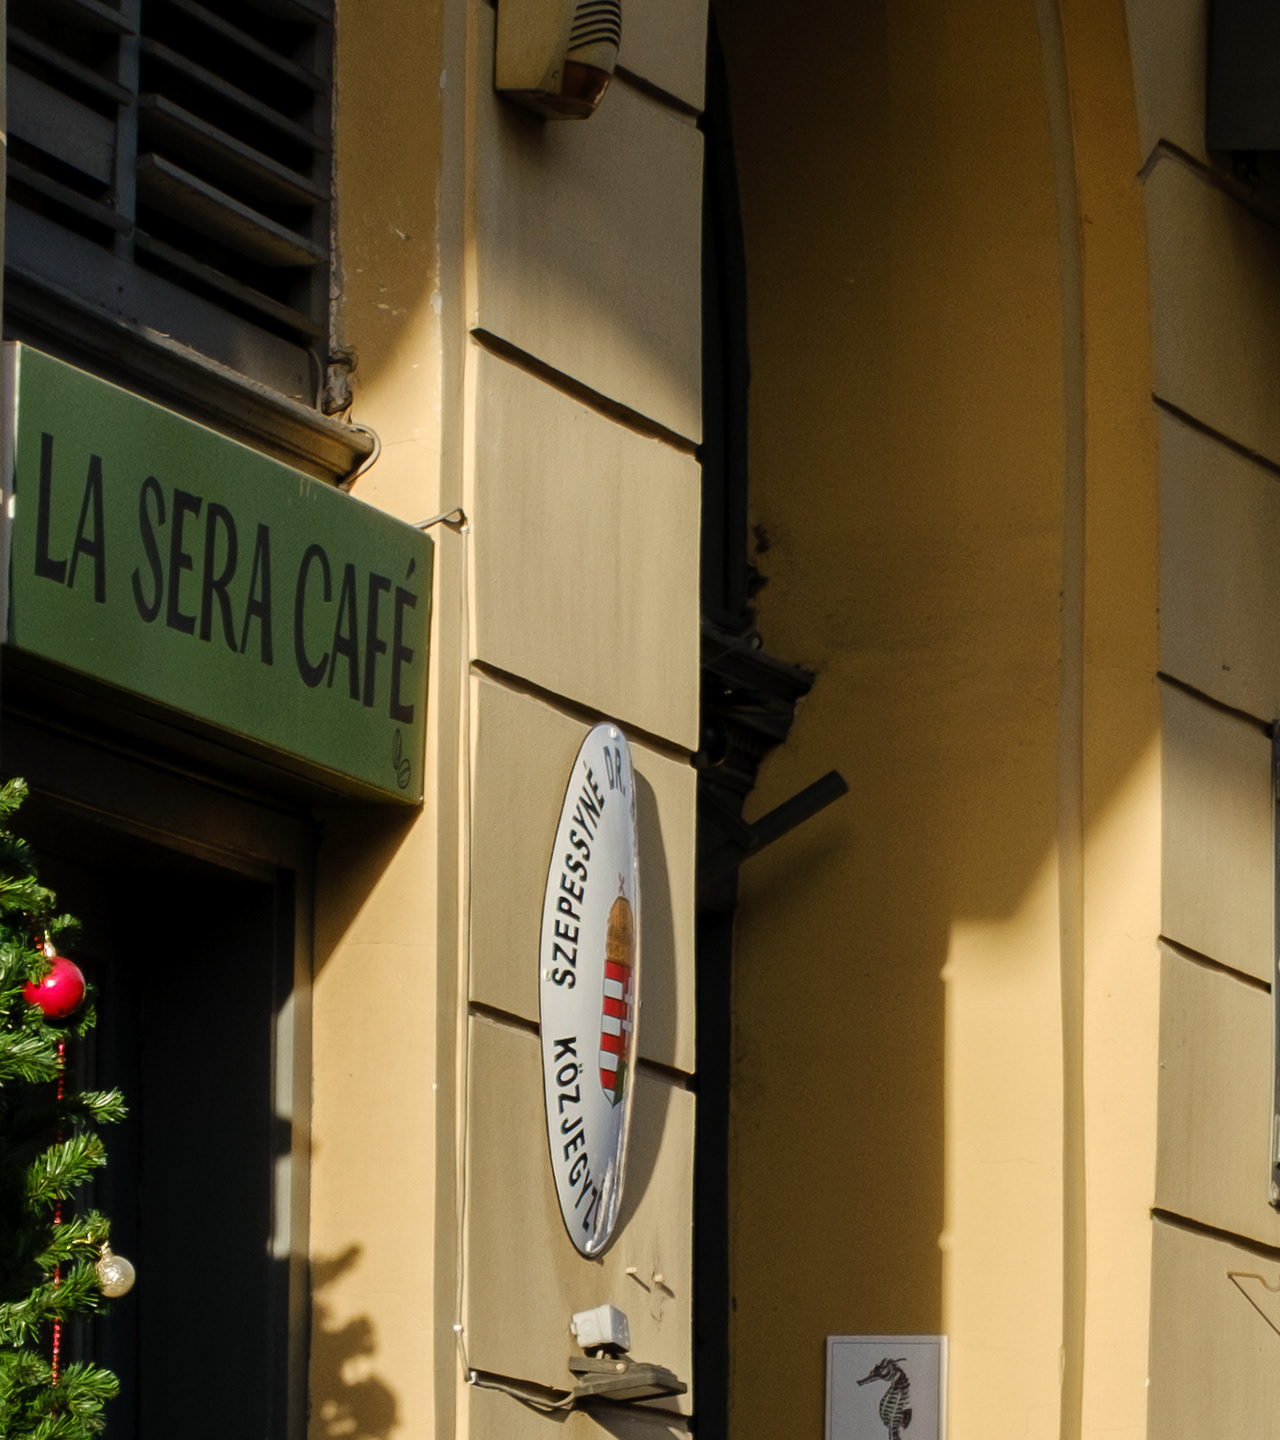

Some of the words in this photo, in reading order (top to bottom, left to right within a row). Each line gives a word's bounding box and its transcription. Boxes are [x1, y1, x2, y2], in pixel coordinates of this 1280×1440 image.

[34, 431, 107, 605] LA
[130, 475, 274, 667] SERA
[293, 542, 419, 725] CAFÉ
[550, 760, 606, 990] SZEPESSYNÉ
[602, 745, 627, 798] DR.
[553, 1036, 604, 1235] KÖZJEGYZ
